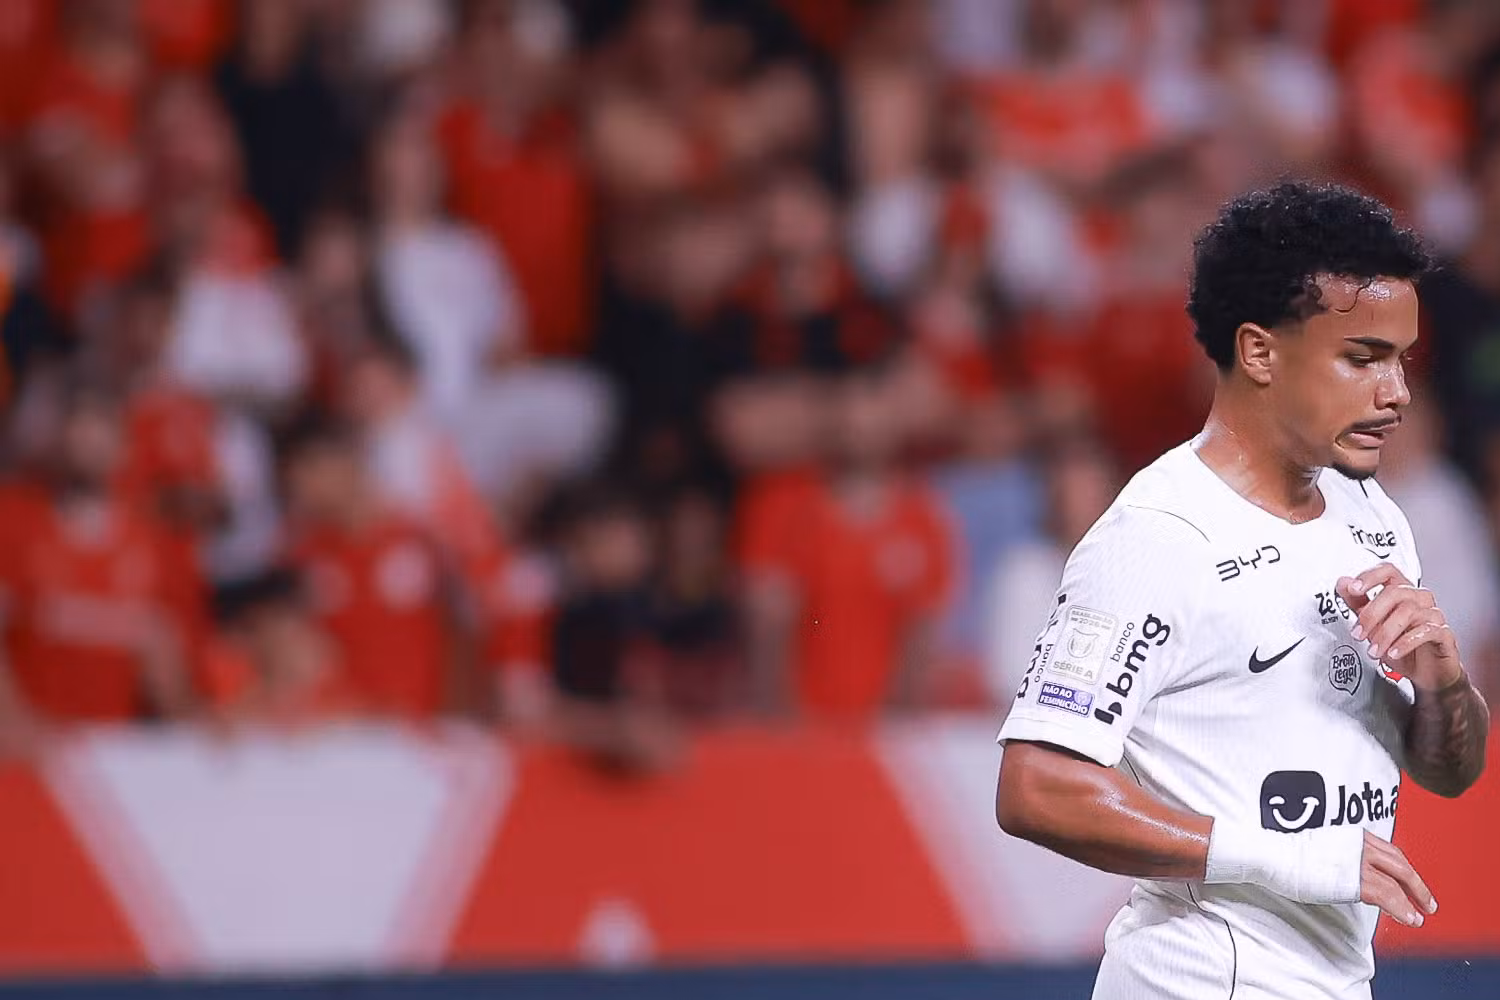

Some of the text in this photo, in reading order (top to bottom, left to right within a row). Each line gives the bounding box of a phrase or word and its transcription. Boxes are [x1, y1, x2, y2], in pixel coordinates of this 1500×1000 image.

[1216, 545, 1281, 582] BYD
[1314, 592, 1337, 617] Zé
[1105, 613, 1171, 698] bmg
[1110, 622, 1135, 663] banco
[1034, 643, 1054, 683] banco
[1053, 660, 1093, 679] SÉRIE A
[1042, 684, 1073, 699] NÃO AO
